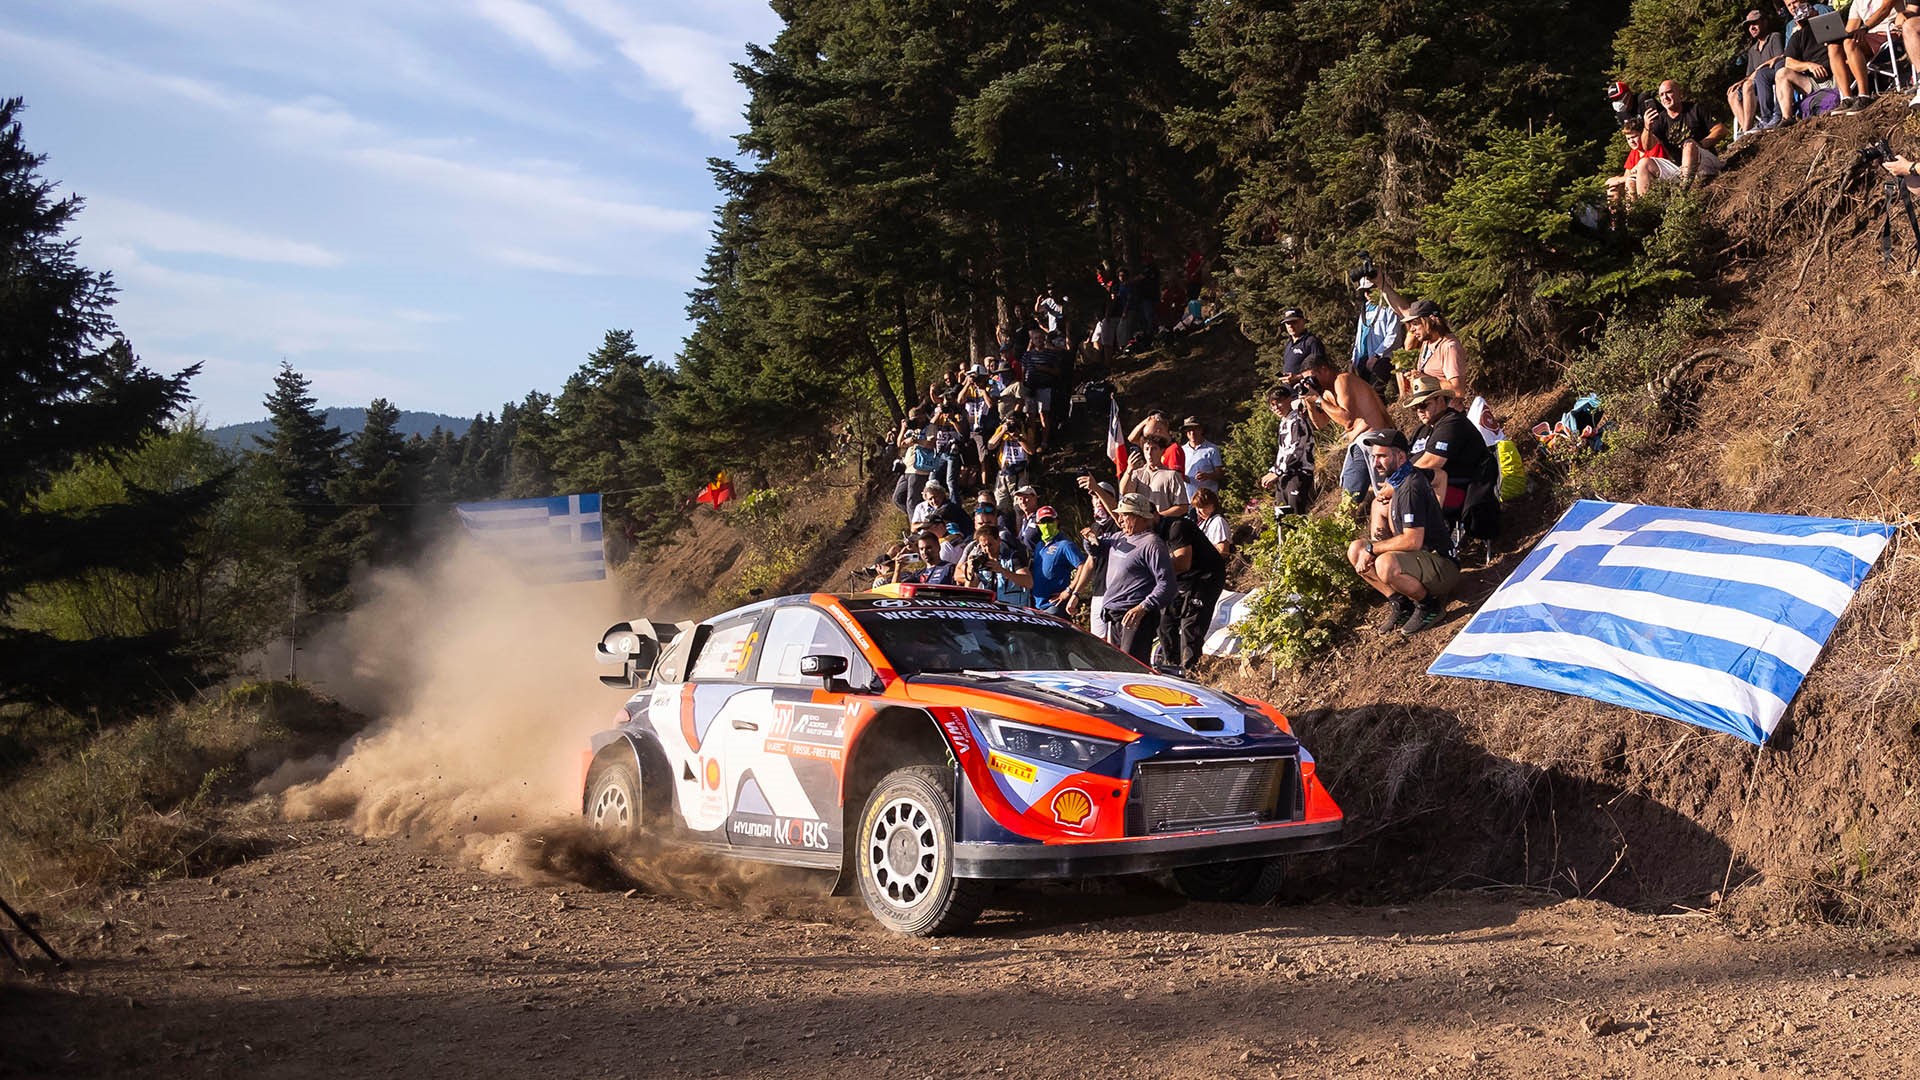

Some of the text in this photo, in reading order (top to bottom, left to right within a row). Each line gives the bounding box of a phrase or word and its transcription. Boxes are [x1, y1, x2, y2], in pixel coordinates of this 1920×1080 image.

[877, 611, 1065, 629] WRC-FANSHOP.COM
[737, 632, 759, 673] 6
[769, 707, 792, 735] HY
[846, 701, 862, 717] N
[990, 755, 1033, 780] PIRELLI
[733, 817, 830, 850] HYUNDAI MOBIS
